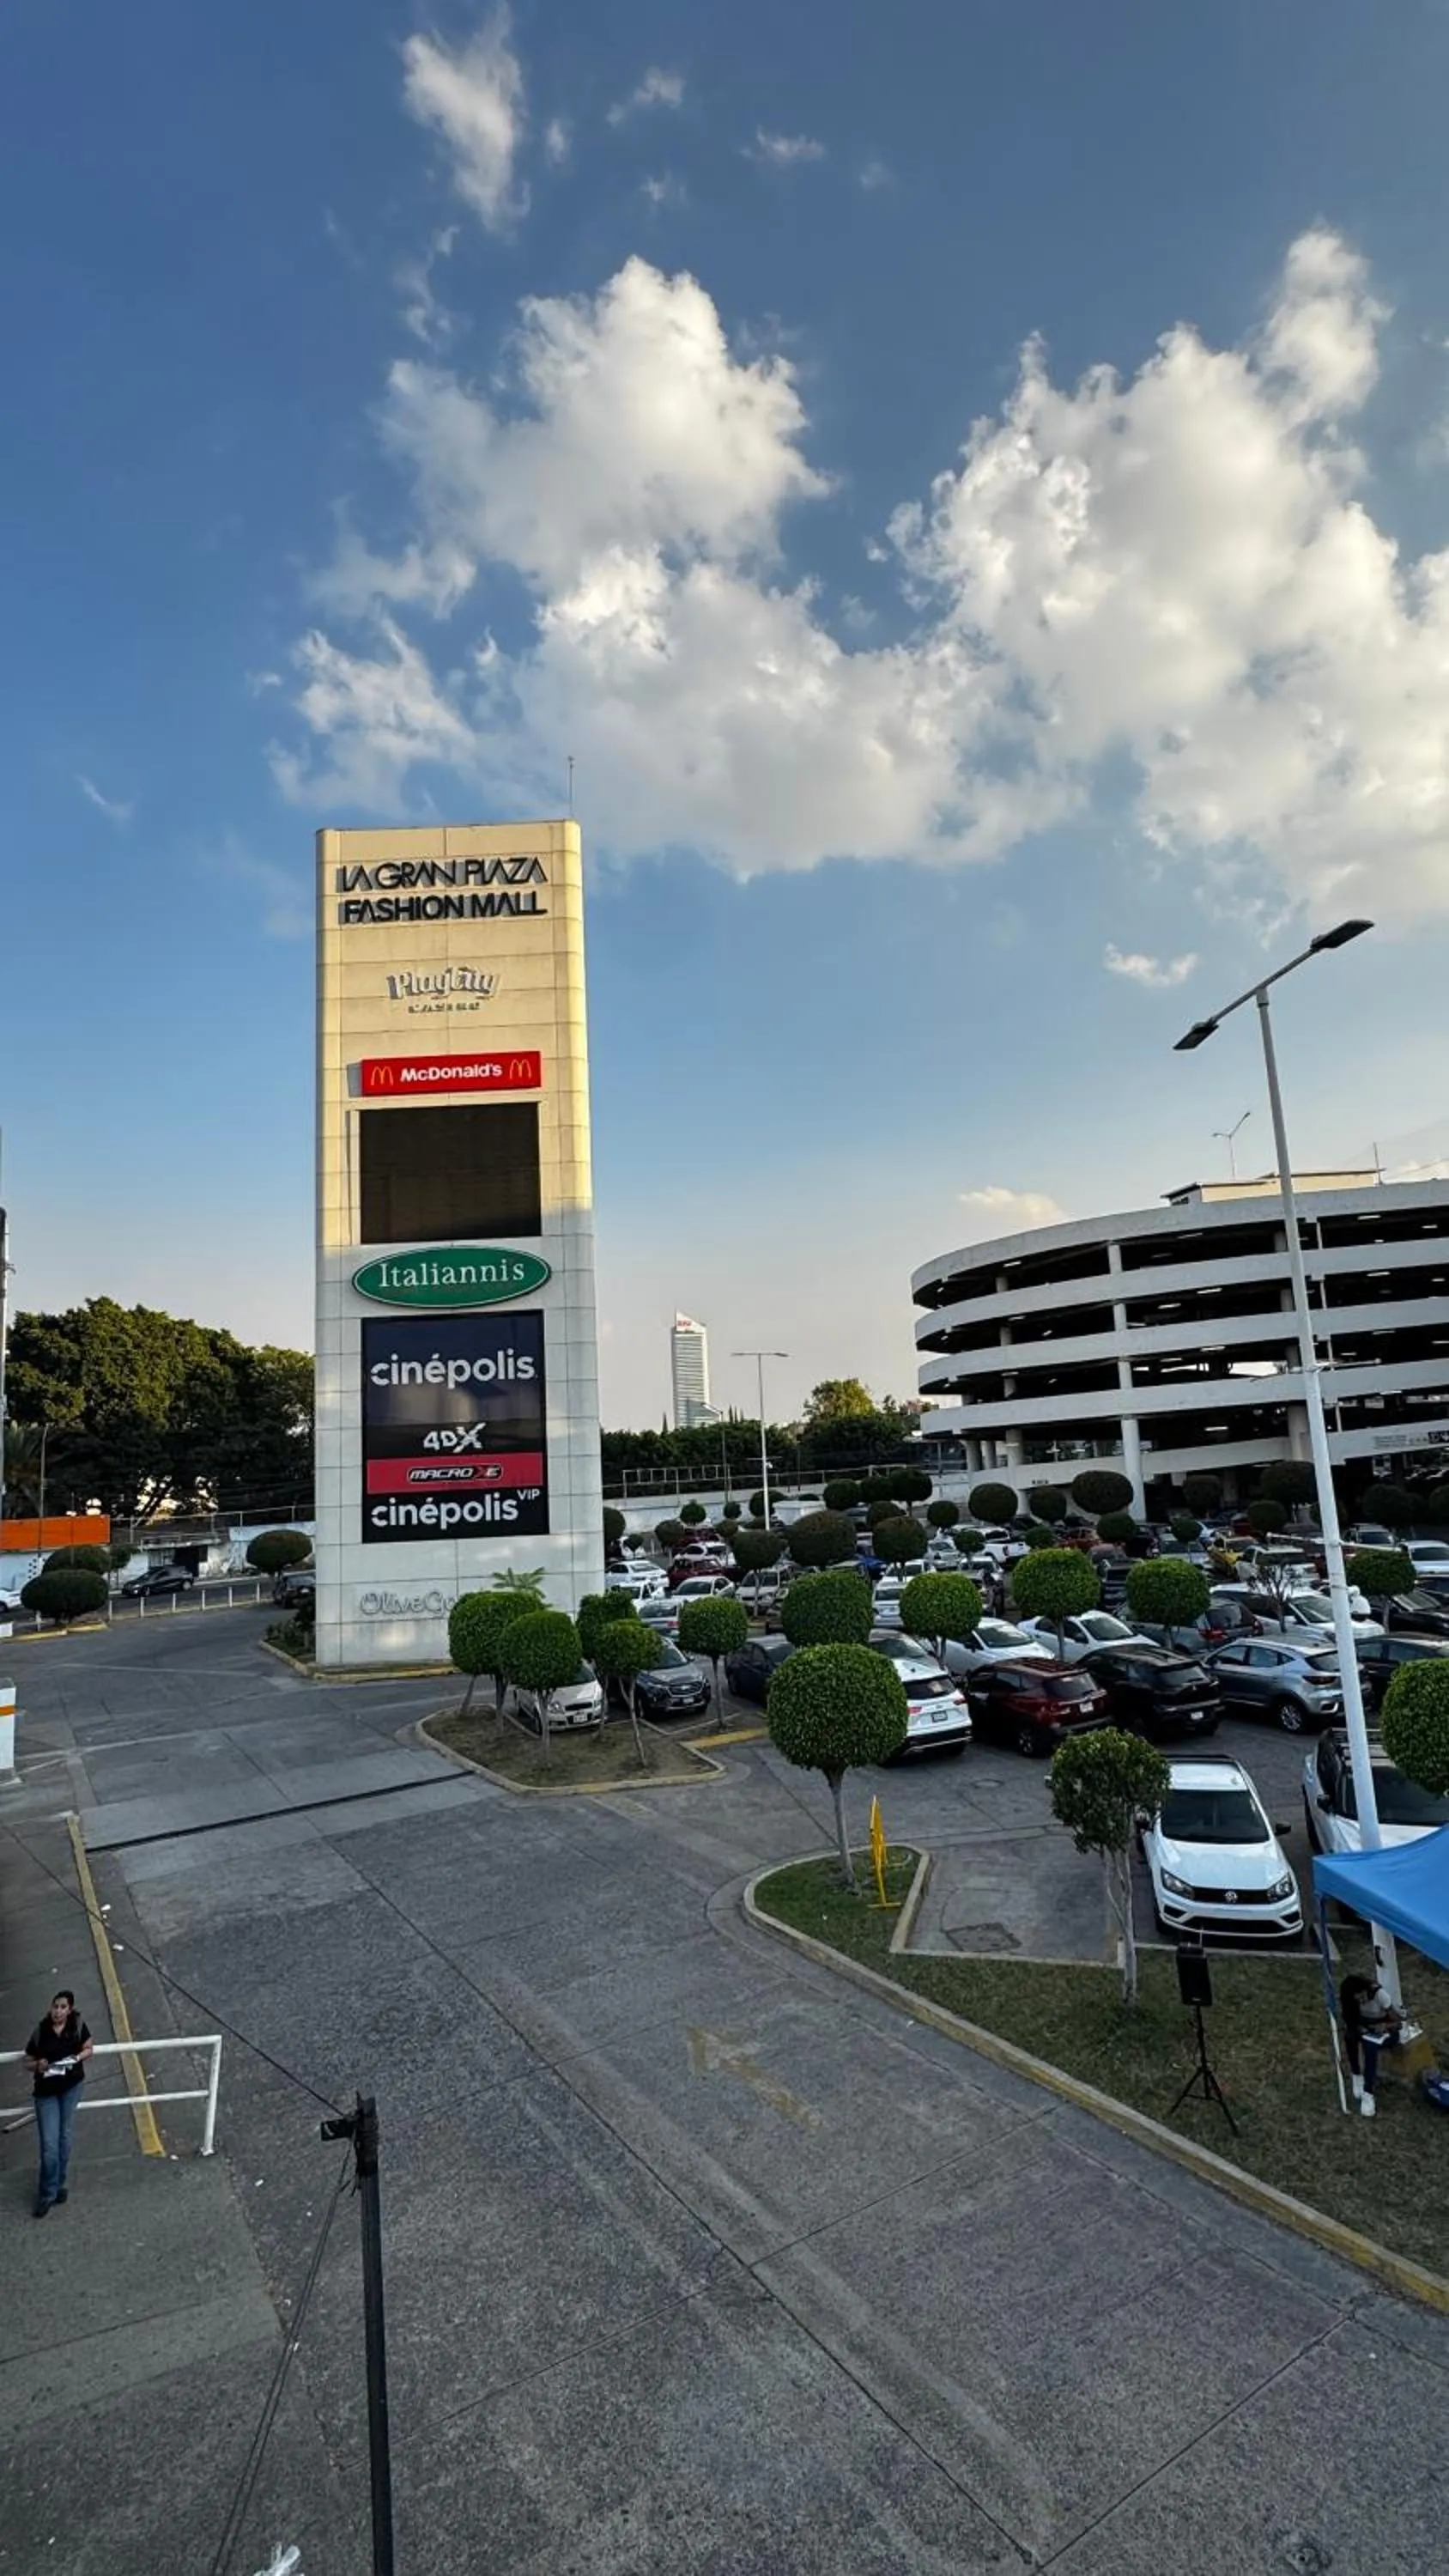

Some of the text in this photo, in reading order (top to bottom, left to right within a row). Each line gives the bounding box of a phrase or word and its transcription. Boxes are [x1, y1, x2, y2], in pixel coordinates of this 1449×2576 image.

[343, 857, 548, 891] LA GRAN PLAZA
[345, 890, 548, 923] FASHION MALL
[400, 1063, 502, 1082] McDonald's
[379, 1258, 524, 1287] Italiannis
[370, 1347, 536, 1389] cinépolis
[423, 1422, 486, 1453] 4DX
[371, 1489, 540, 1530] cinépolis VIP
